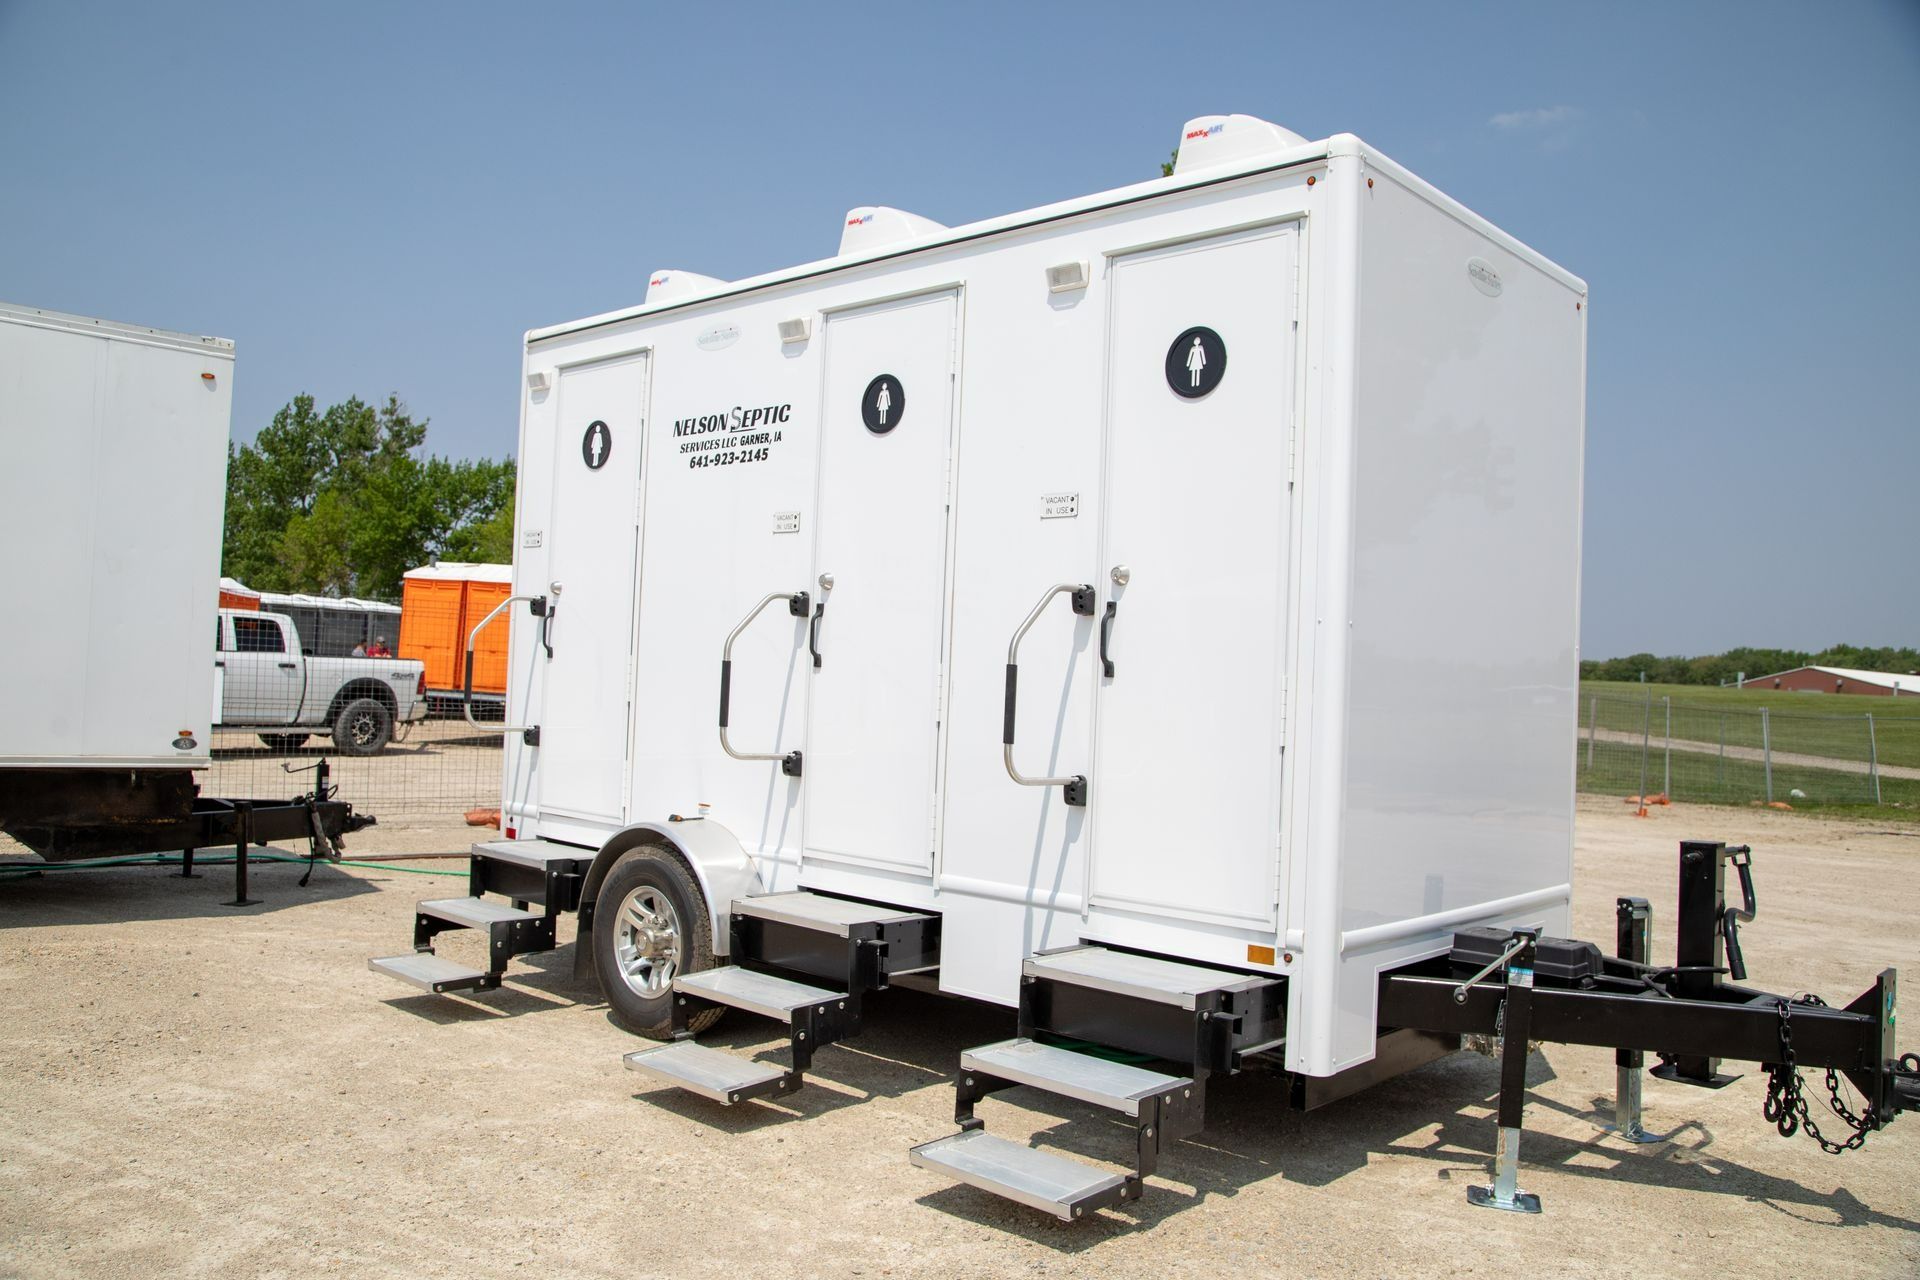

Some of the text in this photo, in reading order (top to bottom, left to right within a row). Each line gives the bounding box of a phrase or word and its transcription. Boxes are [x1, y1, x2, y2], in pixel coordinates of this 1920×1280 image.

[673, 404, 791, 437] NELSON SEPTIC
[680, 431, 782, 454] SERVICES LLC GARNER, IA
[690, 448, 769, 469] 641-923-2145
[1046, 495, 1070, 504] VACANT
[1046, 506, 1070, 515] IN USE
